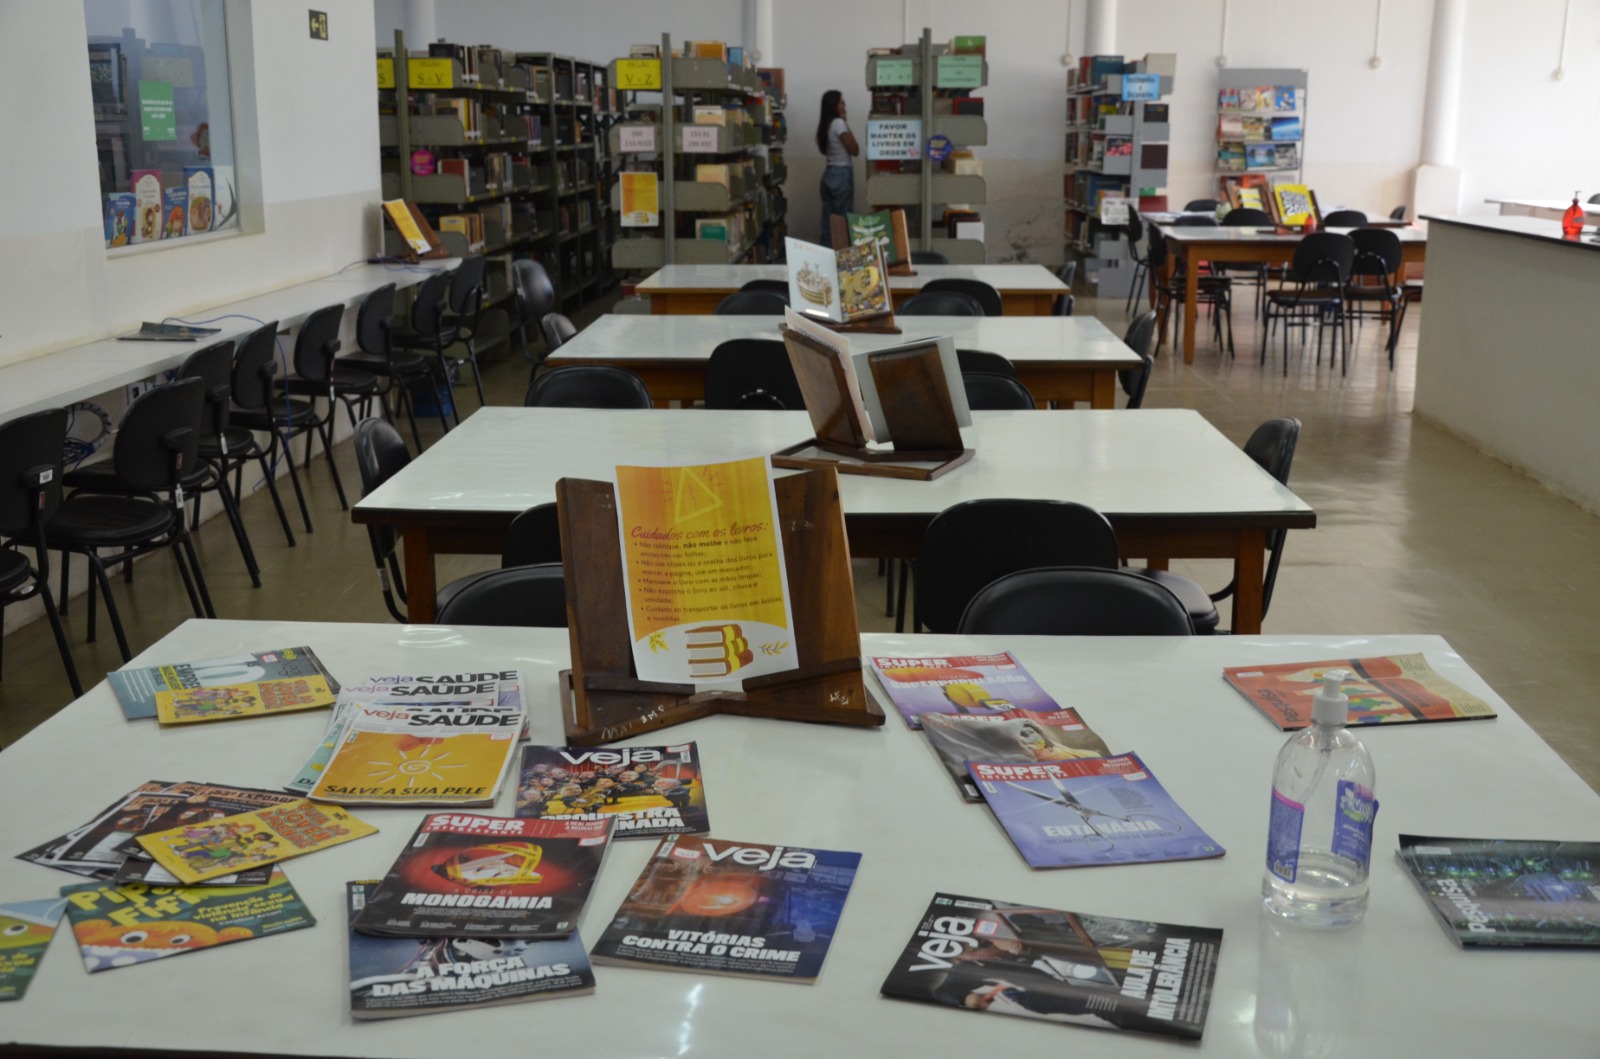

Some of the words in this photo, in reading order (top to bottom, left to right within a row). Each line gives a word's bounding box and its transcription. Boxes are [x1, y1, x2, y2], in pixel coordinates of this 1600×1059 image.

[632, 525, 684, 540] Cuidados
[686, 529, 711, 540] com
[713, 528, 727, 537] os
[699, 539, 722, 547] molhe
[877, 657, 950, 668] SUPER
[369, 674, 414, 684] veja
[415, 670, 519, 684] SAÚDE
[344, 685, 391, 694] veja
[390, 681, 497, 697] SAÚDE
[363, 708, 410, 721] veja
[408, 712, 523, 728] SAÚDE
[559, 749, 663, 768] veja
[977, 763, 1062, 776] SUPER
[323, 785, 384, 795] SALVE
[384, 786, 397, 795] A
[400, 786, 438, 795] SUA
[441, 786, 488, 795] PELE
[275, 807, 334, 842] JOVEM
[431, 814, 525, 831] SUPER
[703, 842, 818, 871] veja
[253, 894, 295, 909] sexual
[268, 892, 284, 900] de
[400, 892, 554, 910] MONOGAMIA
[210, 915, 228, 923] na
[667, 928, 767, 949] VITÓRIAS
[908, 915, 979, 972] veja
[622, 934, 709, 956] CONTRA
[710, 944, 728, 956] O
[729, 946, 802, 963] CRIME
[1129, 949, 1157, 968] DE
[416, 965, 435, 980] A
[438, 956, 527, 977] FORÇA
[1120, 967, 1153, 1001] AULA
[1146, 937, 1192, 1021] INTOLERÂNCIA
[372, 980, 428, 998] DAS
